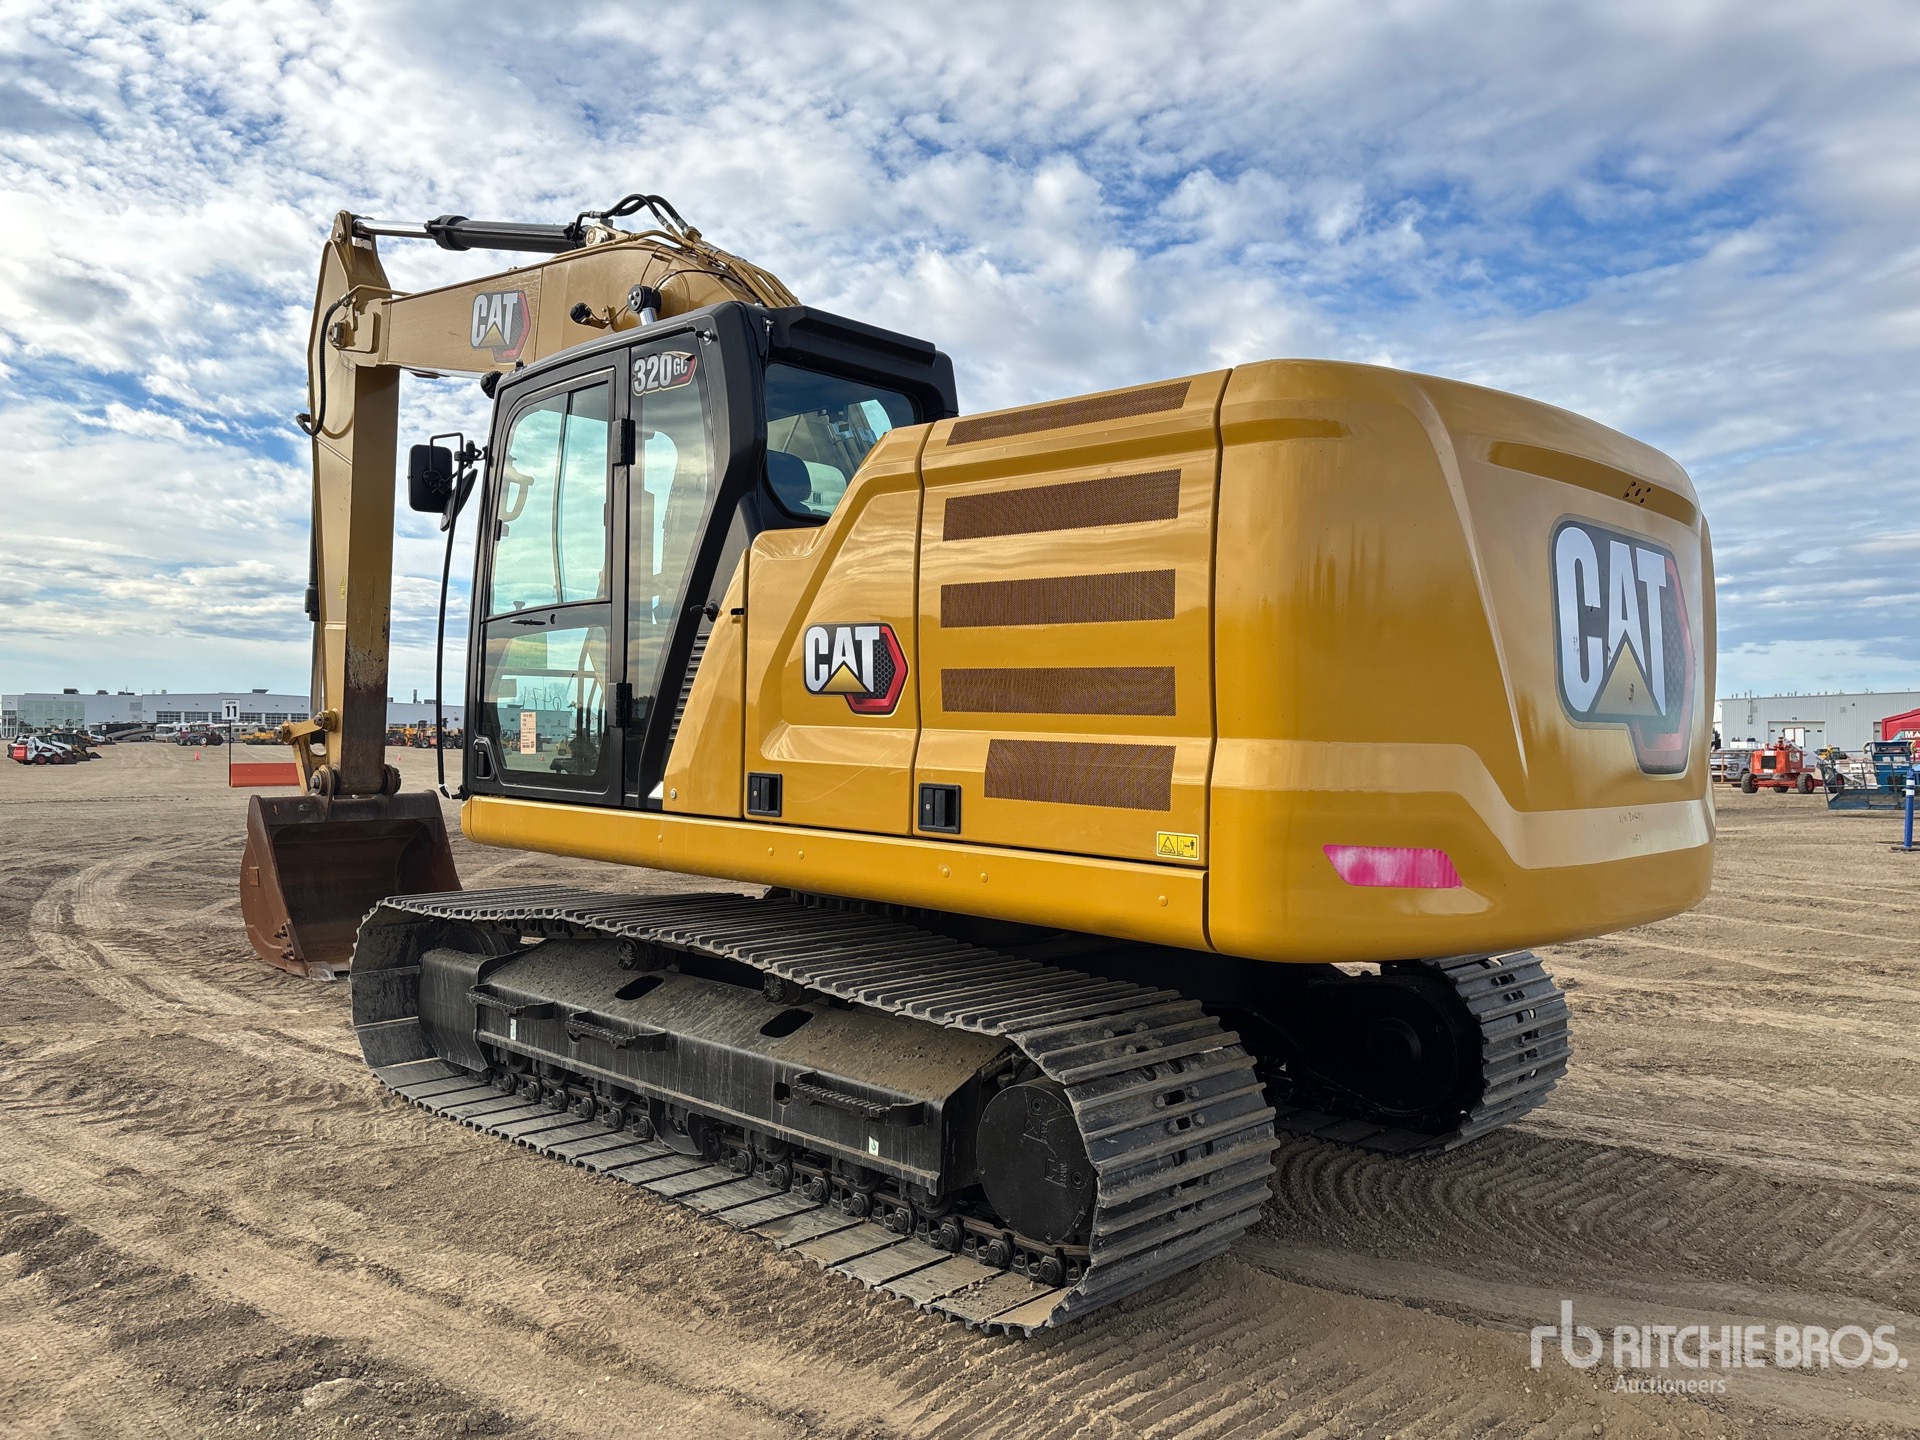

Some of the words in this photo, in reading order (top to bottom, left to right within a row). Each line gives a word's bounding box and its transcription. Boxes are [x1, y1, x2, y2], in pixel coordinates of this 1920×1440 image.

[471, 292, 518, 347] CAT
[634, 354, 672, 392] 320
[673, 357, 688, 376] GC
[1555, 526, 1667, 716] CAT
[805, 625, 880, 693] CAT
[225, 705, 236, 717] 11
